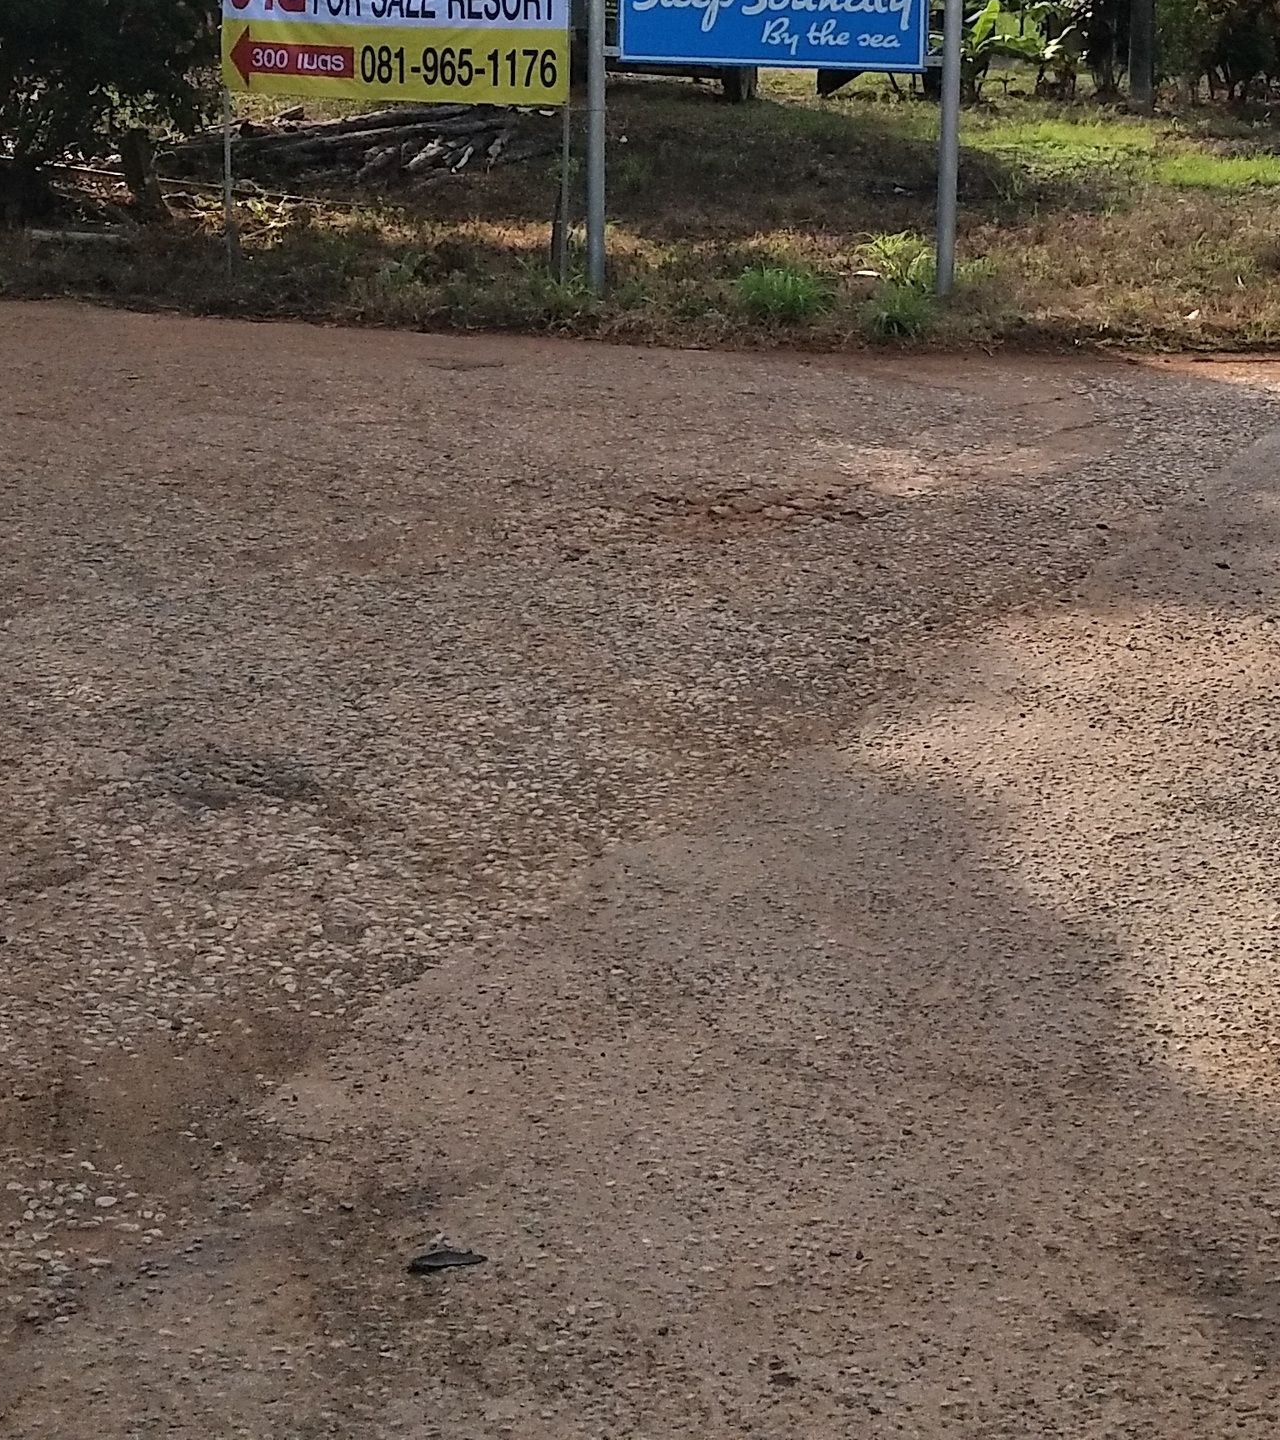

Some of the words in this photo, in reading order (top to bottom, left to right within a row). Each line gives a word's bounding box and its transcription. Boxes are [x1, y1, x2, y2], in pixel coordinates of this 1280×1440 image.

[761, 17, 800, 55] By
[806, 18, 850, 46] the
[857, 31, 901, 48] sea
[251, 48, 289, 68] 300
[296, 51, 345, 72] เมตร
[360, 45, 557, 88] 081-965-1176
